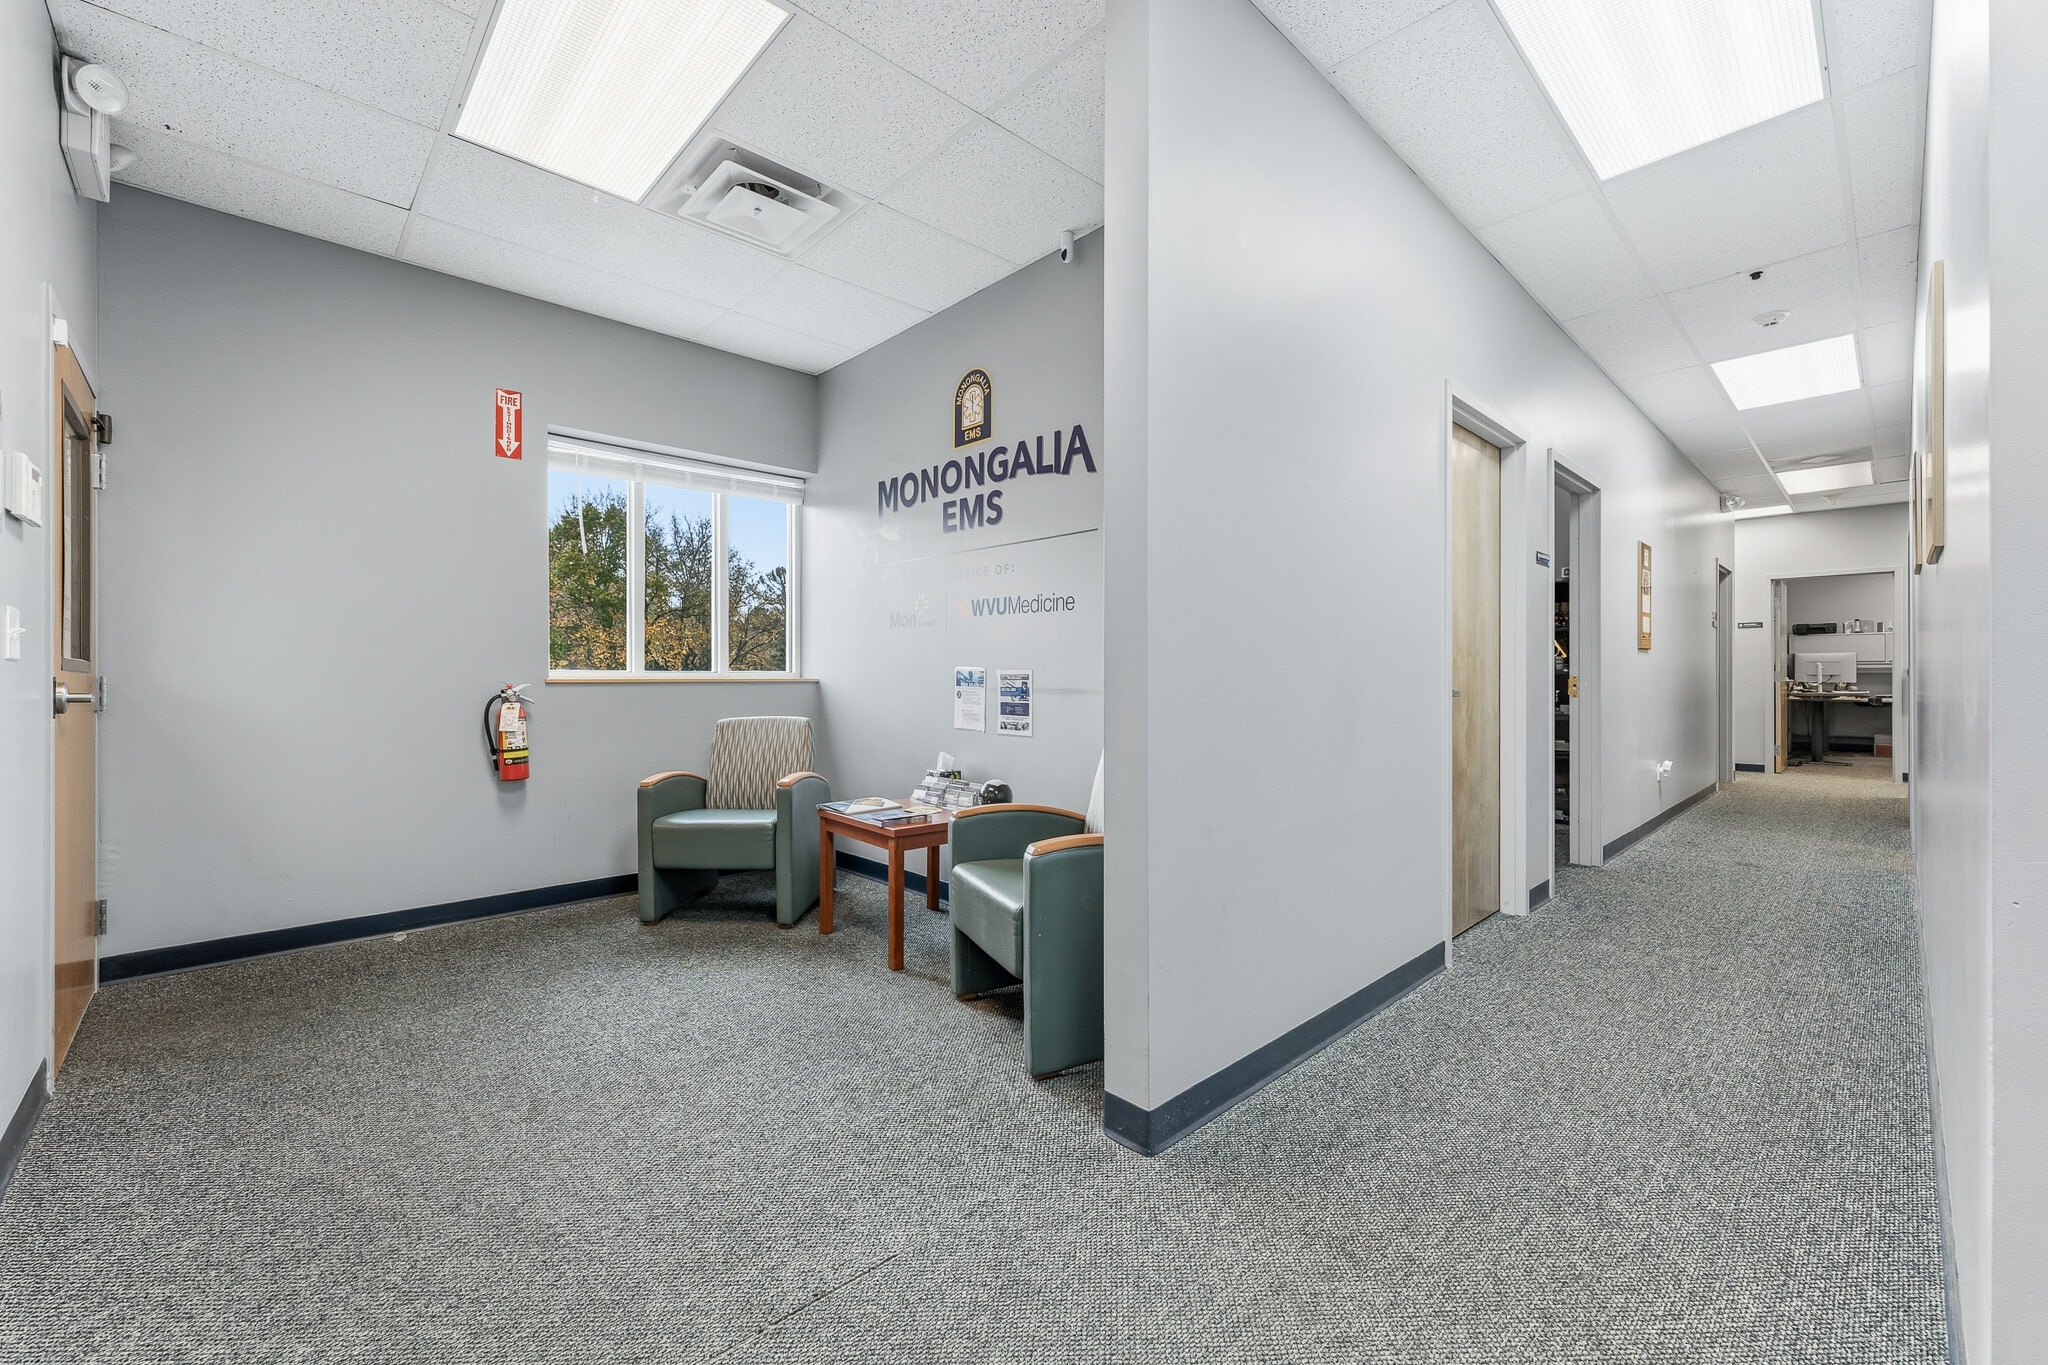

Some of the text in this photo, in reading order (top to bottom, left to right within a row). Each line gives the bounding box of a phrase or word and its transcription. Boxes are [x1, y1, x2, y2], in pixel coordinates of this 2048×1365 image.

[956, 373, 990, 405] MONONGALIA
[500, 395, 518, 407] FIRE
[964, 427, 981, 441] EMS
[877, 424, 1098, 521] MONONGALIA
[942, 489, 1004, 534] EMS
[994, 563, 1016, 576] OF:
[889, 611, 917, 629] Mon
